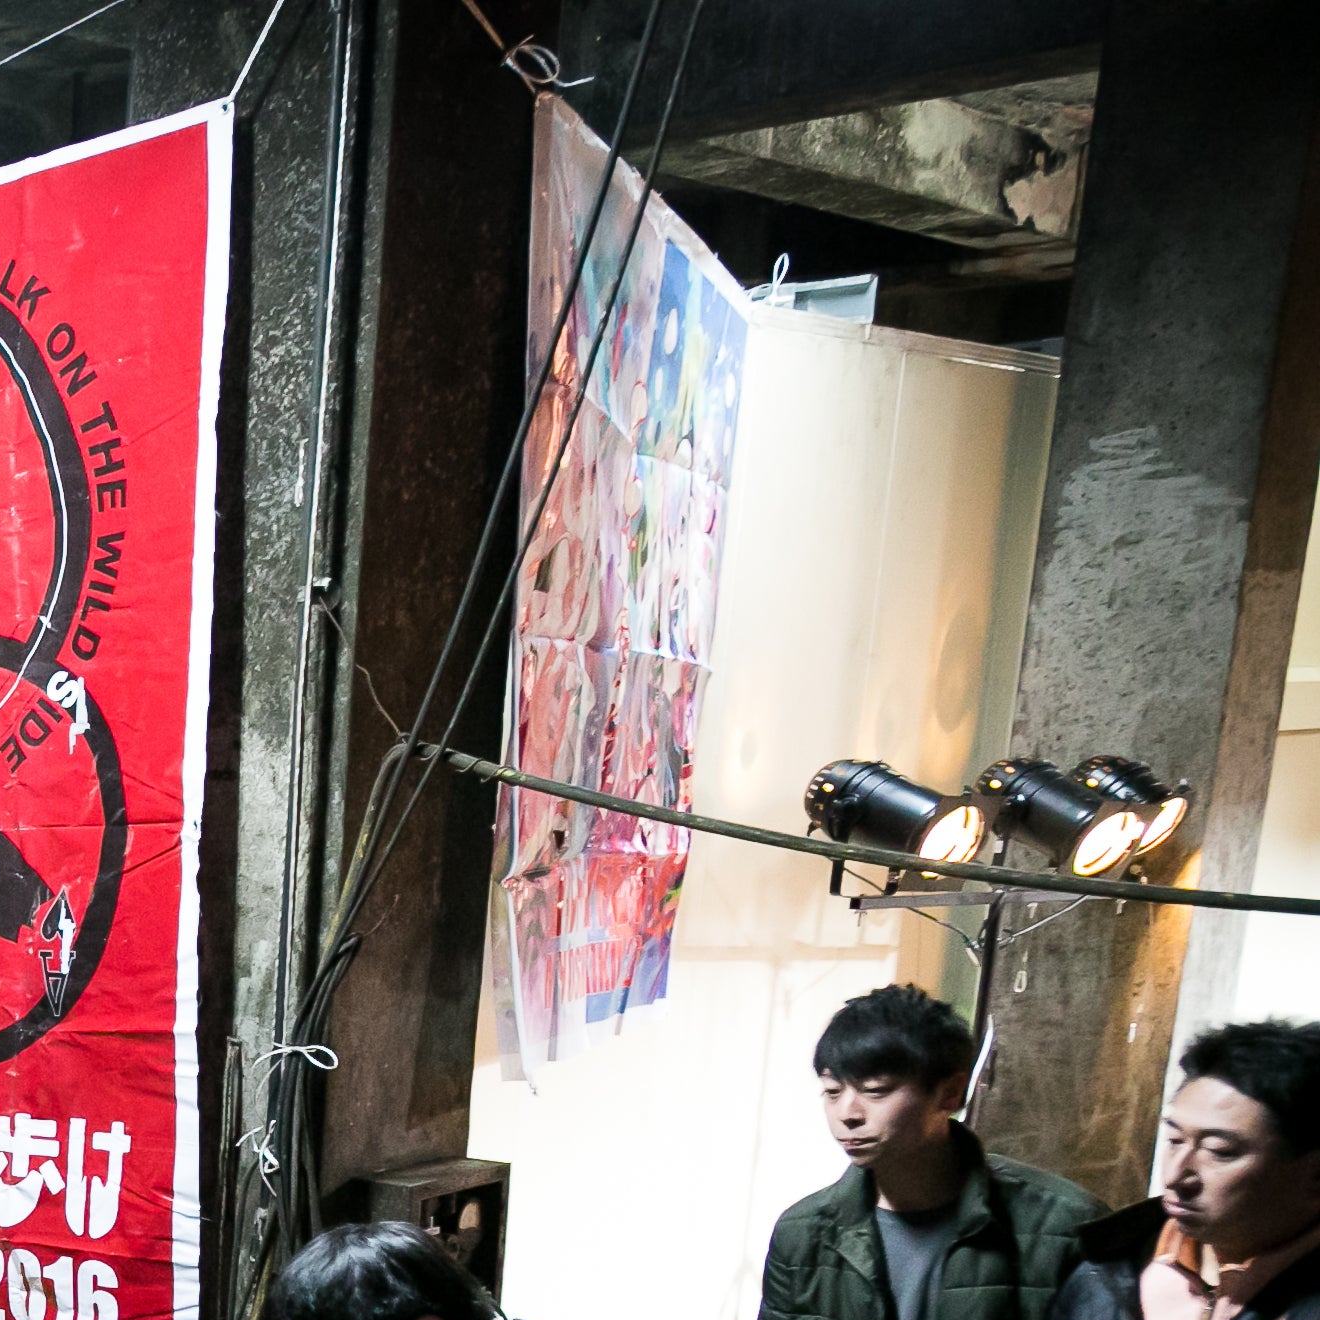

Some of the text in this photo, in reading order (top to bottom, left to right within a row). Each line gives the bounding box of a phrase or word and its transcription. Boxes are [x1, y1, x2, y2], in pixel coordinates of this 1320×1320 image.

[45, 322, 98, 398] ON
[80, 401, 127, 513] THE
[71, 530, 127, 662] WILD
[0, 670, 80, 774] SIDE
